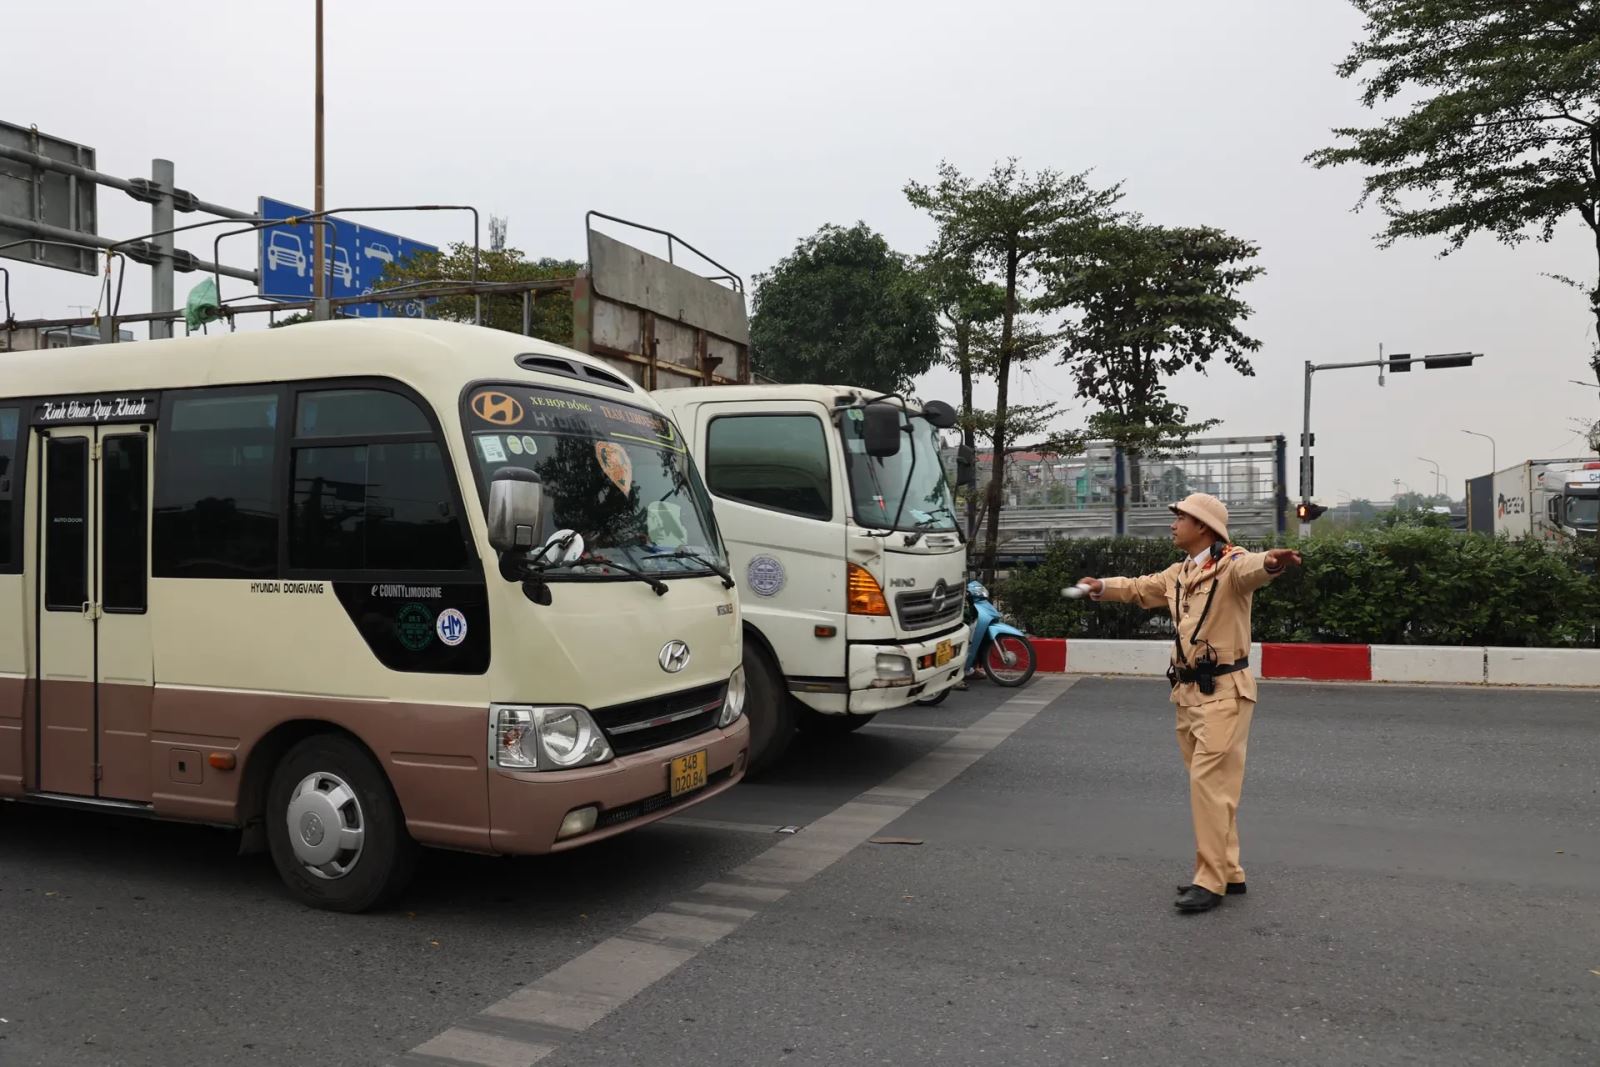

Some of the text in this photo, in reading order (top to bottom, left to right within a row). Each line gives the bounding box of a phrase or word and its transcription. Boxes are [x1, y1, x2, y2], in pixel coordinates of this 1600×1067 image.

[250, 583, 324, 594] HYUNDAI DONGVANG
[890, 578, 916, 587] HINO
[441, 614, 462, 637] HM
[681, 754, 698, 774] 34B
